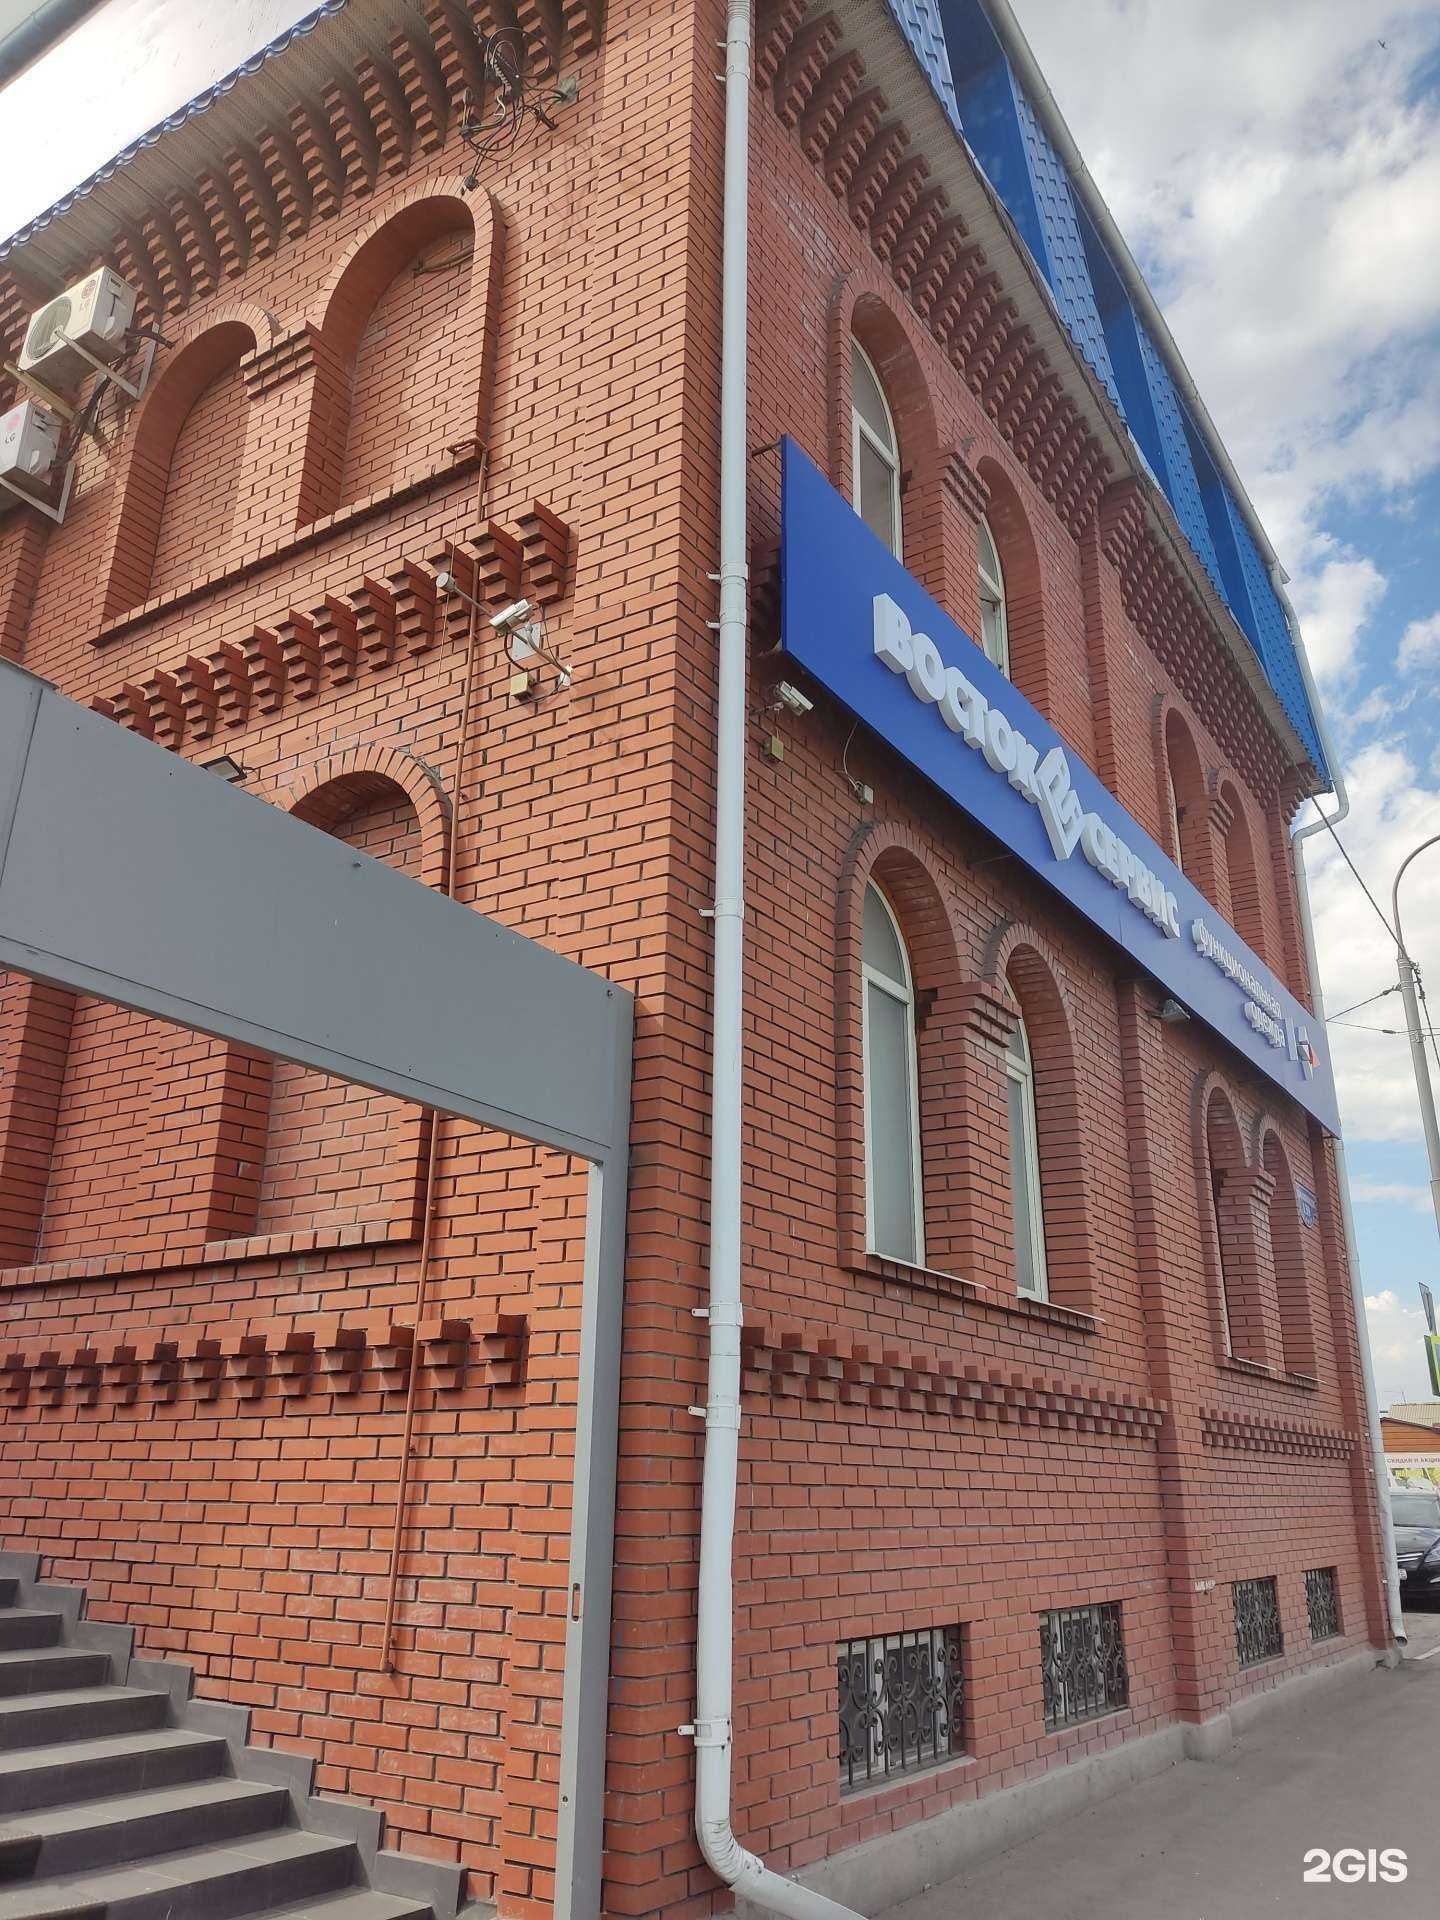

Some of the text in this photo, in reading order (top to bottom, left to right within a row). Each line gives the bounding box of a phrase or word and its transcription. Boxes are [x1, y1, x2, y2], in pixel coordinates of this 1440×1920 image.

[5, 432, 16, 444] LG
[873, 593, 1181, 939] ВОСТОК СЕРВИС
